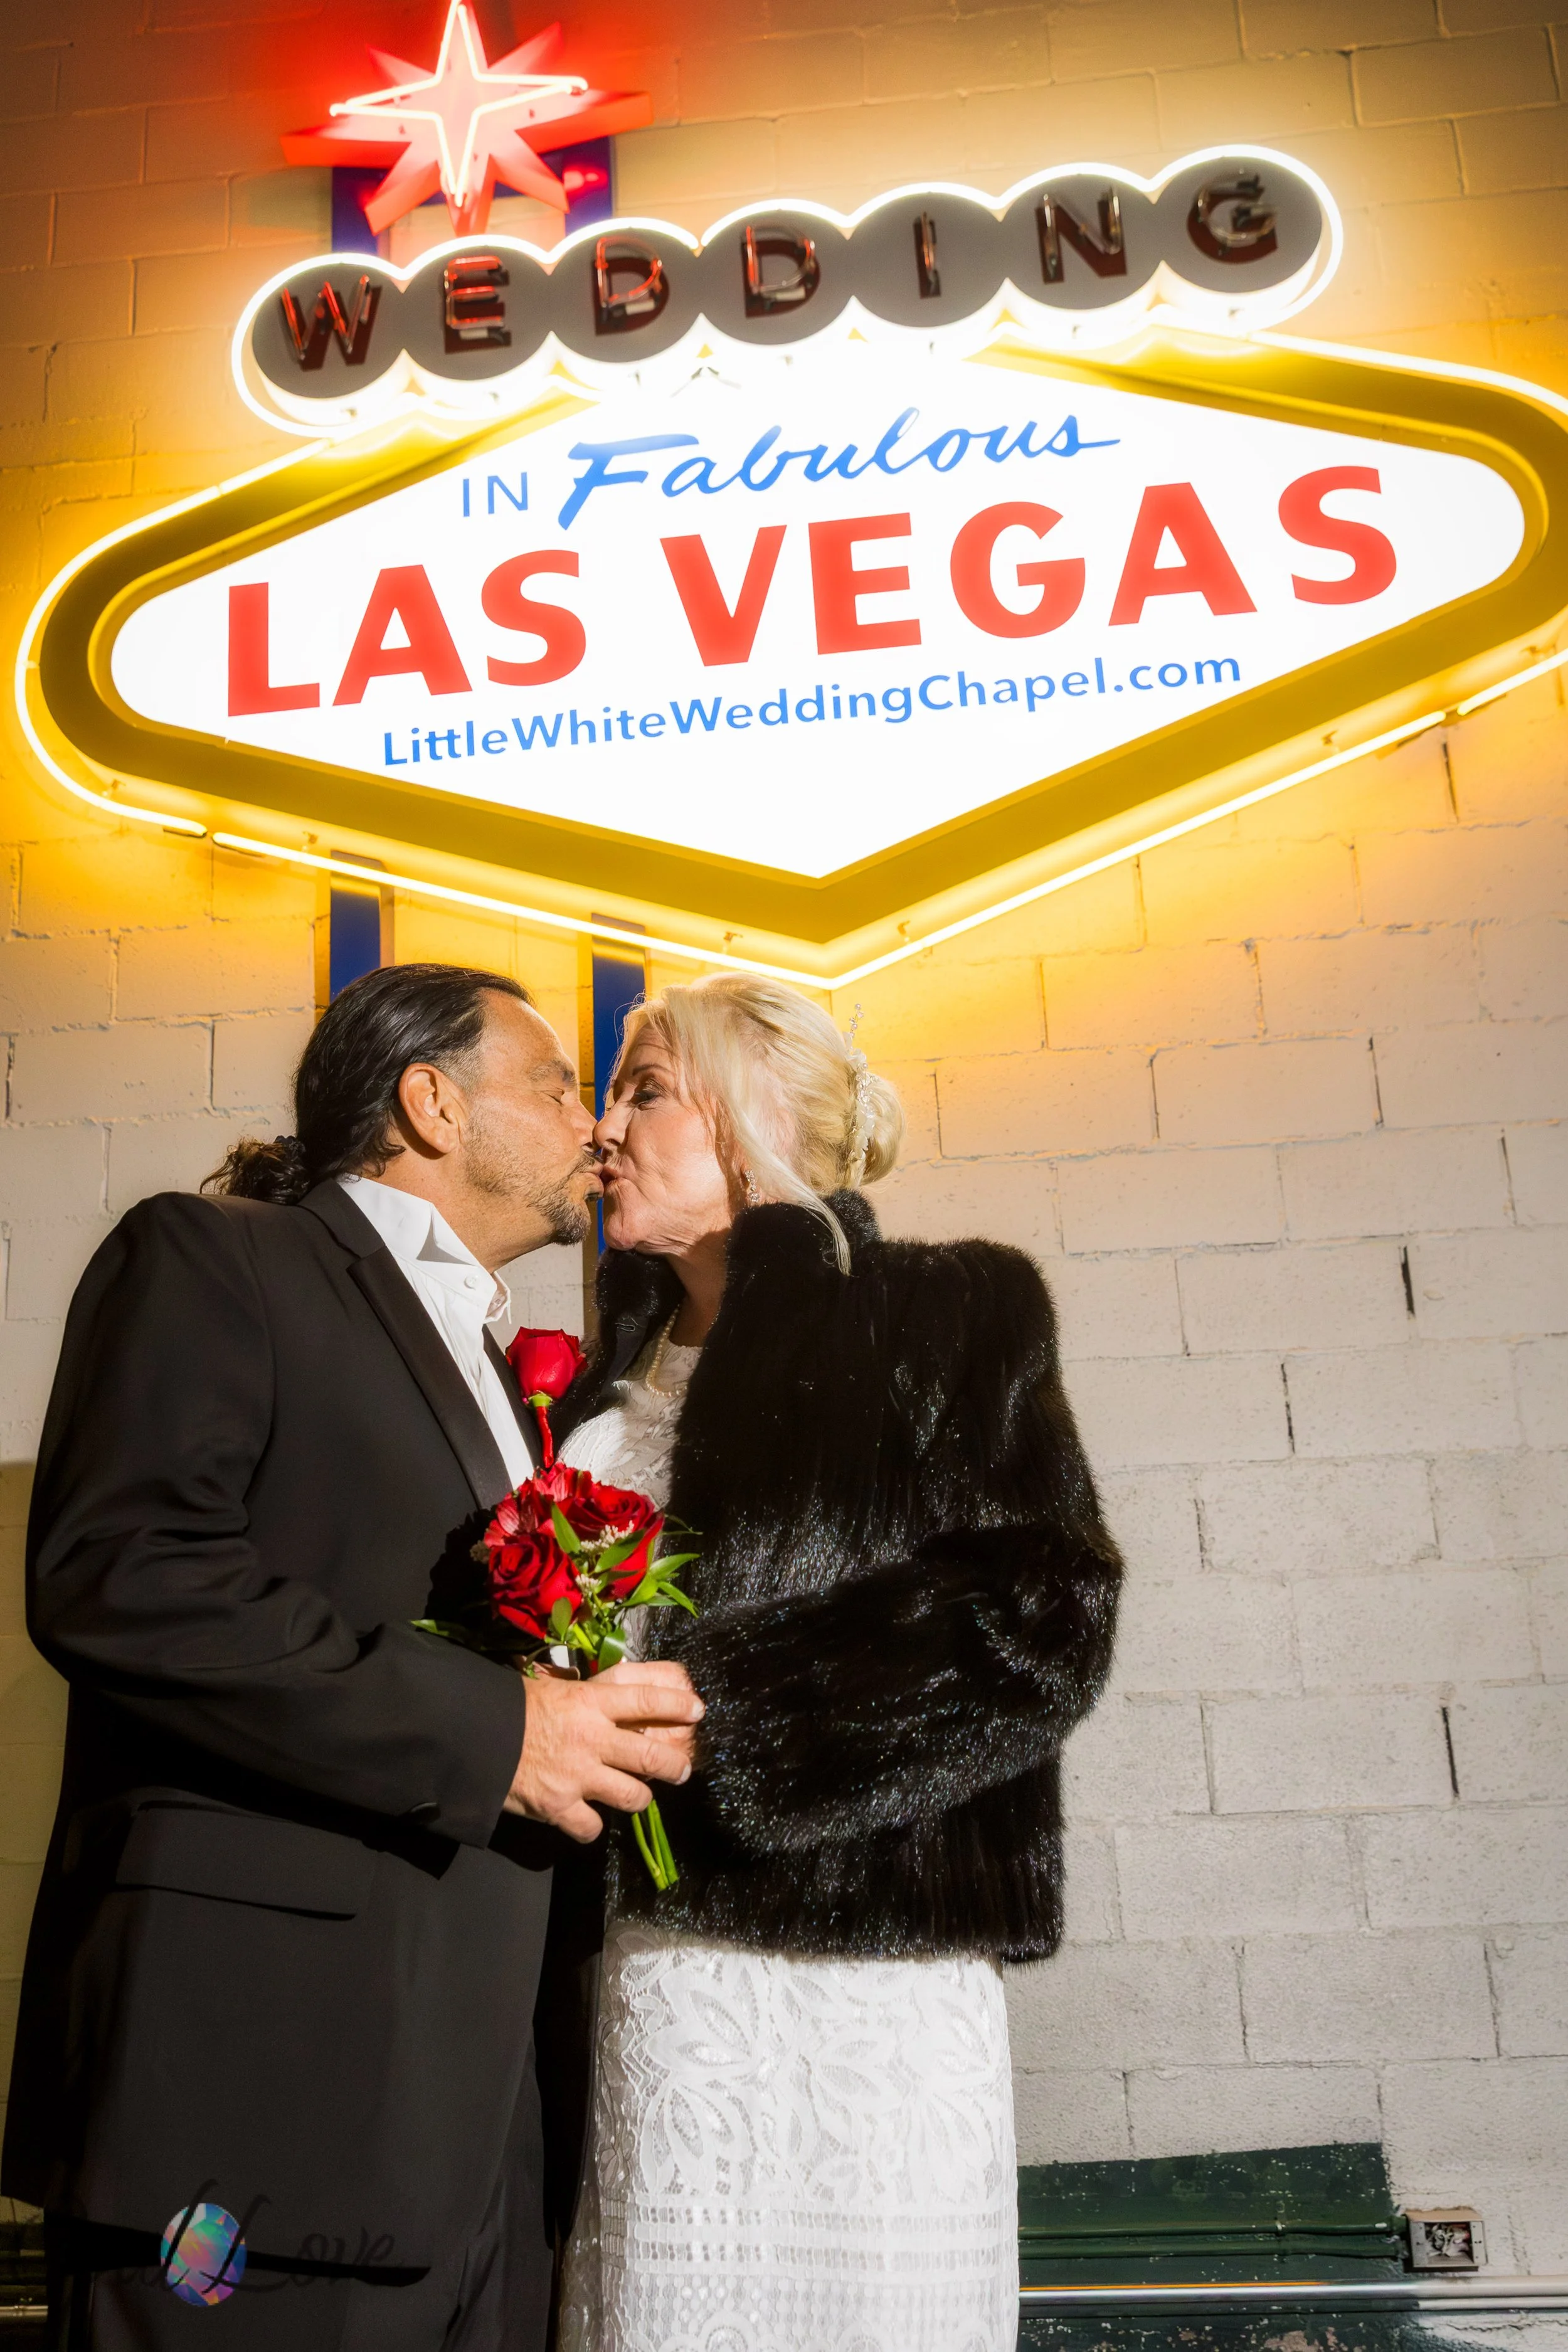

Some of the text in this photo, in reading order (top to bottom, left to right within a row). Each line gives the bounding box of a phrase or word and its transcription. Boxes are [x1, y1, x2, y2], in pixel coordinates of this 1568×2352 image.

[281, 167, 1279, 371] WEDDING
[462, 408, 1121, 531] IN Fabulous
[228, 465, 1397, 717] LAS VEGAS
[384, 656, 1241, 766] LittleWhiteWeddingChapel.com
